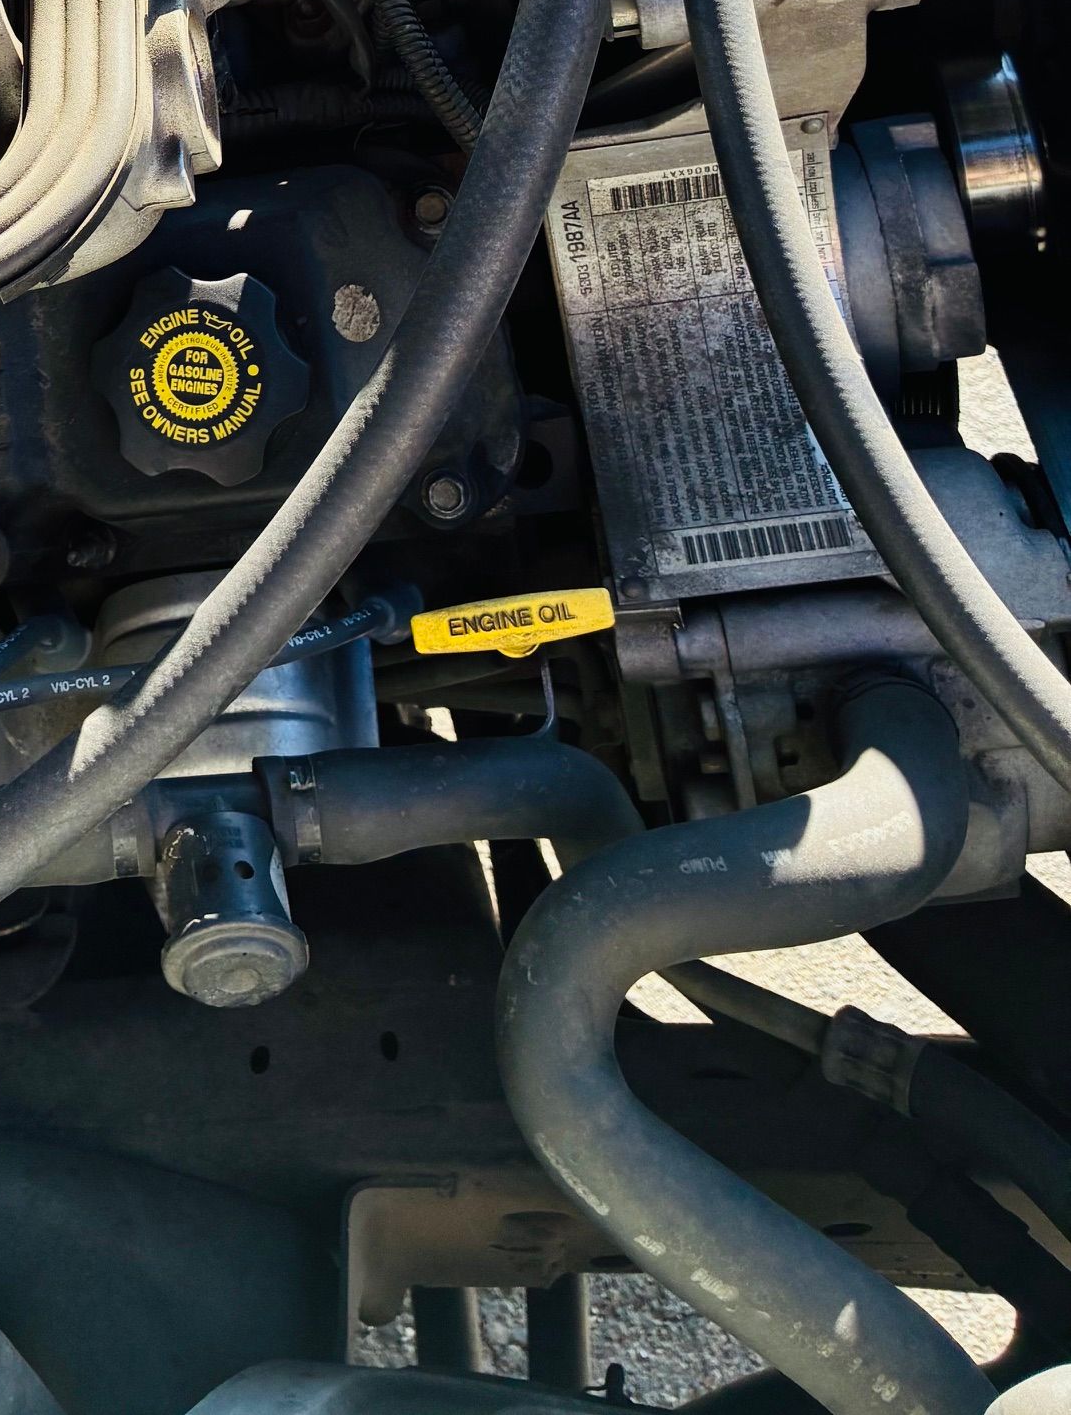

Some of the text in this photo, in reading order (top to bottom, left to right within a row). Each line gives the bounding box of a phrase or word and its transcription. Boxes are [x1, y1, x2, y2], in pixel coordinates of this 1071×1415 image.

[139, 309, 255, 360] ENGINE OIL
[158, 337, 234, 392] AMERICAN PETROLEUM INSTITUTE
[185, 349, 209, 365] FOR
[169, 364, 223, 382] GASOLINE
[170, 379, 219, 396] ENGINES
[130, 368, 262, 444] SEE OWNERS MANUAL
[167, 397, 219, 415] CERTIFIED
[448, 601, 578, 637] ENGINE OIL
[21, 686, 30, 701] 2
[50, 675, 99, 694] V10-CYL
[102, 673, 111, 686] 2
[679, 855, 728, 874] PUMP
